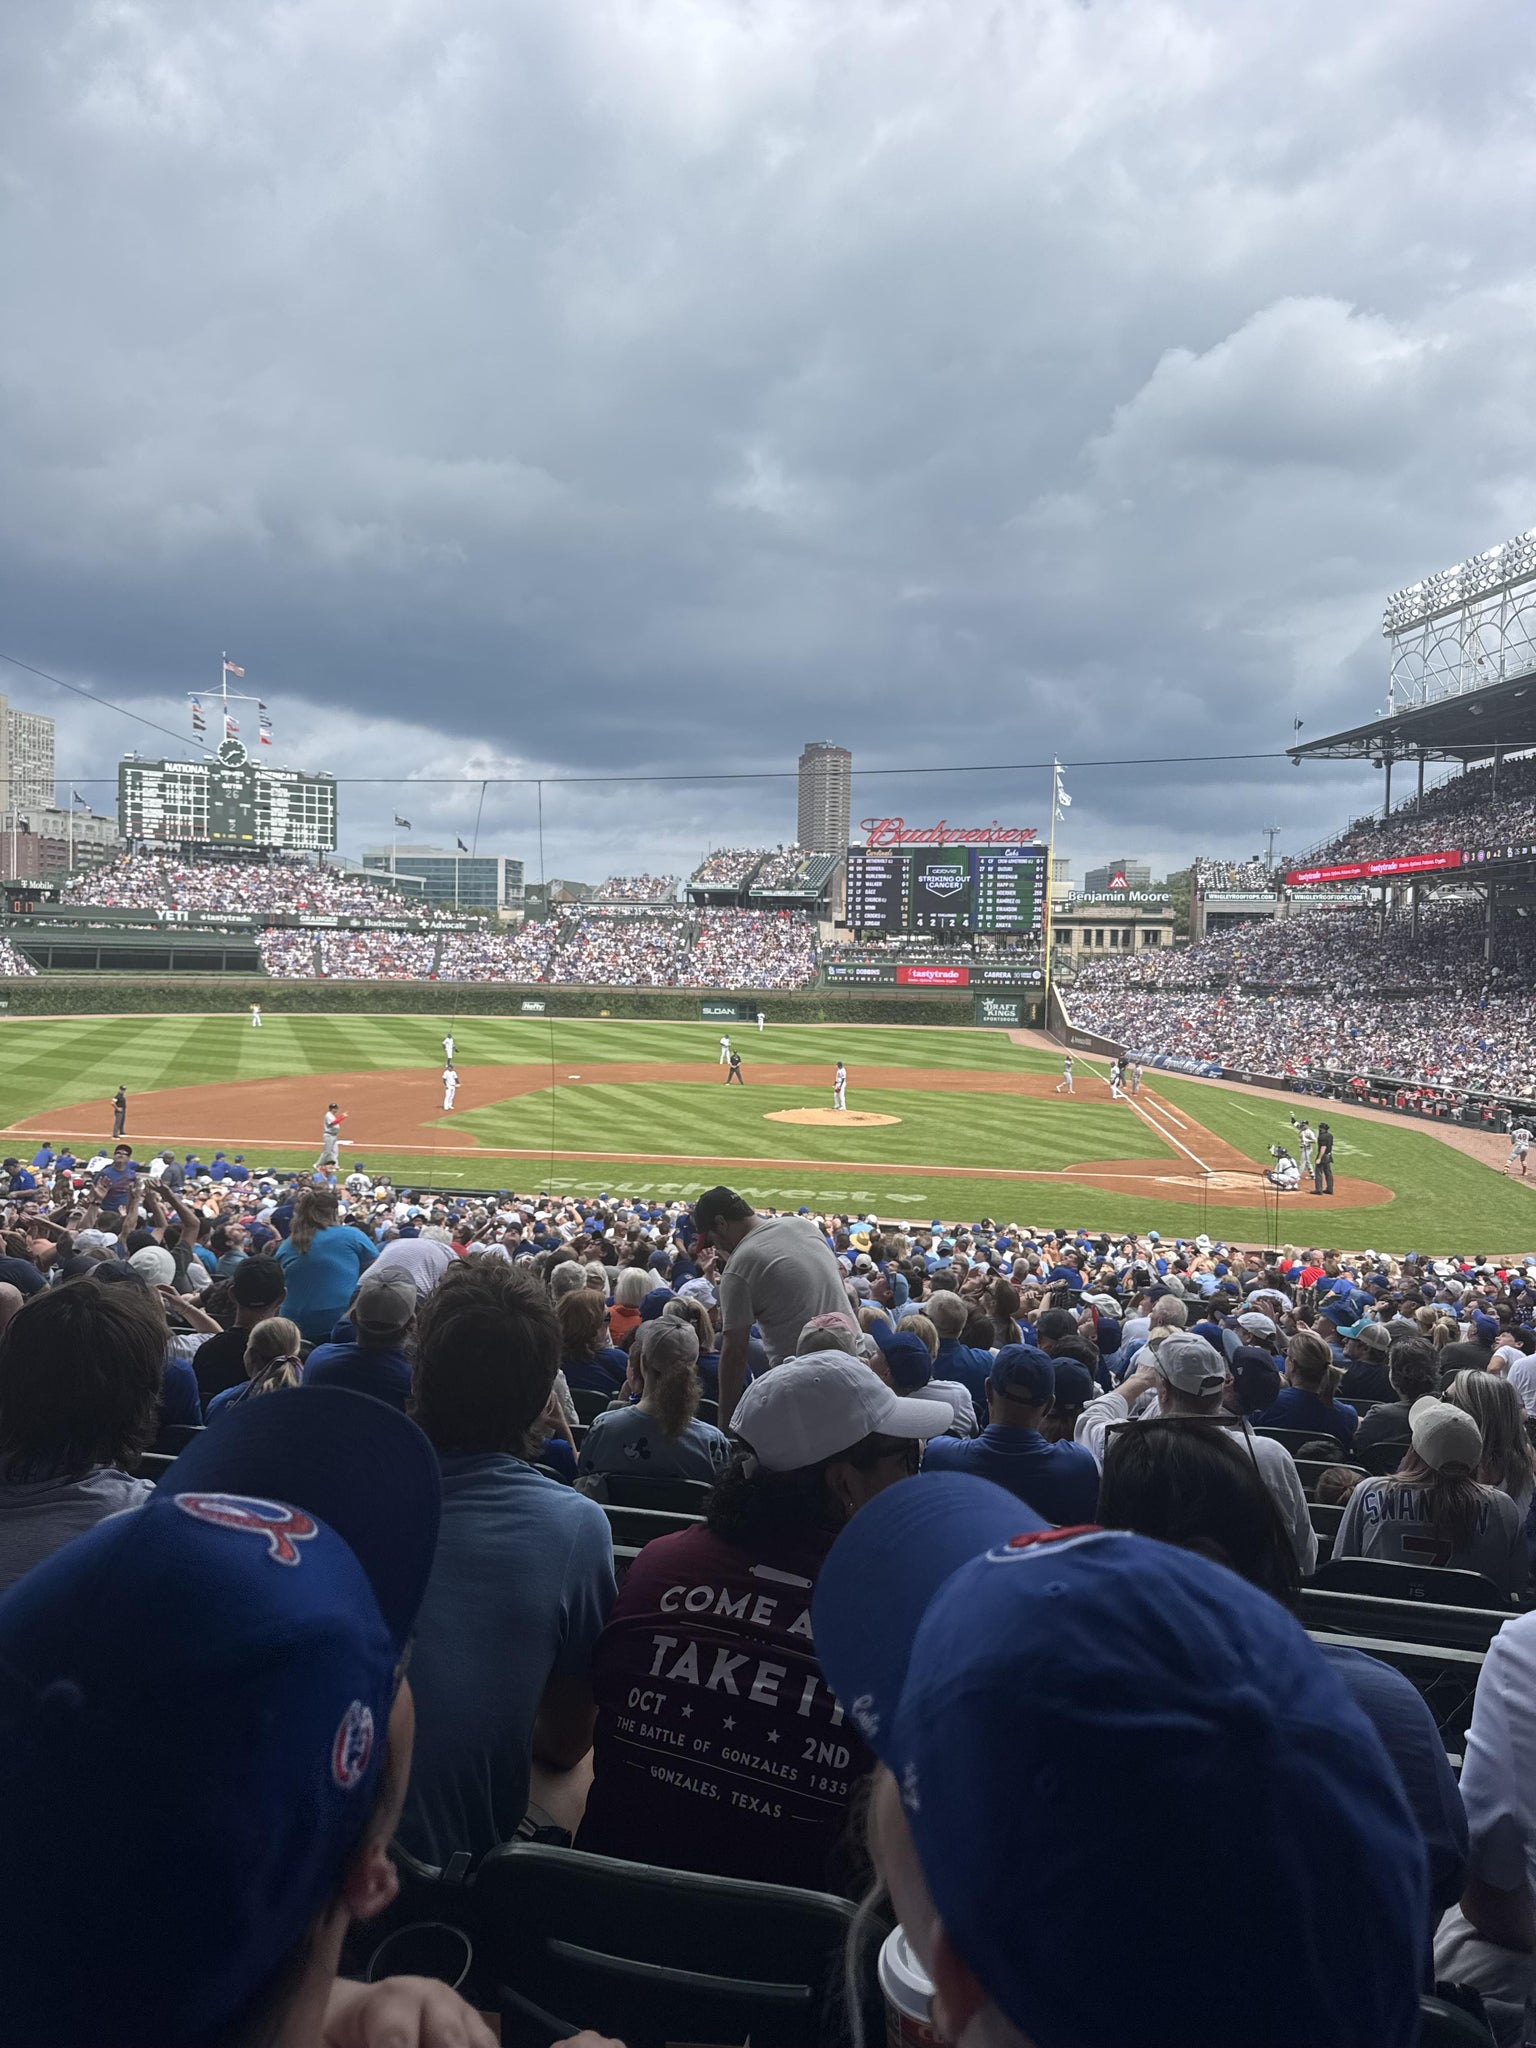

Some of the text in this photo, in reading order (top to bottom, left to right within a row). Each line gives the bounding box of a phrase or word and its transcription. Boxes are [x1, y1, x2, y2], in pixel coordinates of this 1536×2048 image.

[164, 762, 210, 774] NATIONAL
[254, 771, 298, 780] AMERICAN
[226, 790, 239, 798] 26
[860, 817, 1038, 846] Budweiser
[1370, 861, 1397, 873] tastytrade
[1298, 871, 1320, 881] tastytrade
[29, 880, 54, 890] Mobile
[1068, 891, 1169, 903] Benjamin Moore
[156, 910, 188, 921] YETI
[206, 914, 252, 923] tastytrade
[364, 919, 407, 927] Budweiser
[430, 920, 466, 929] Advocate
[912, 970, 959, 979] tastytrade
[1363, 1488, 1489, 1536] SWANN
[659, 1584, 778, 1626] COME
[649, 1634, 787, 1706] TAKE
[628, 1687, 850, 1769] OCT 2ND
[617, 1716, 848, 1795] THE BATTLE OF GONZALES 1835
[650, 1766, 782, 1818] GONZALES, TEXAS
